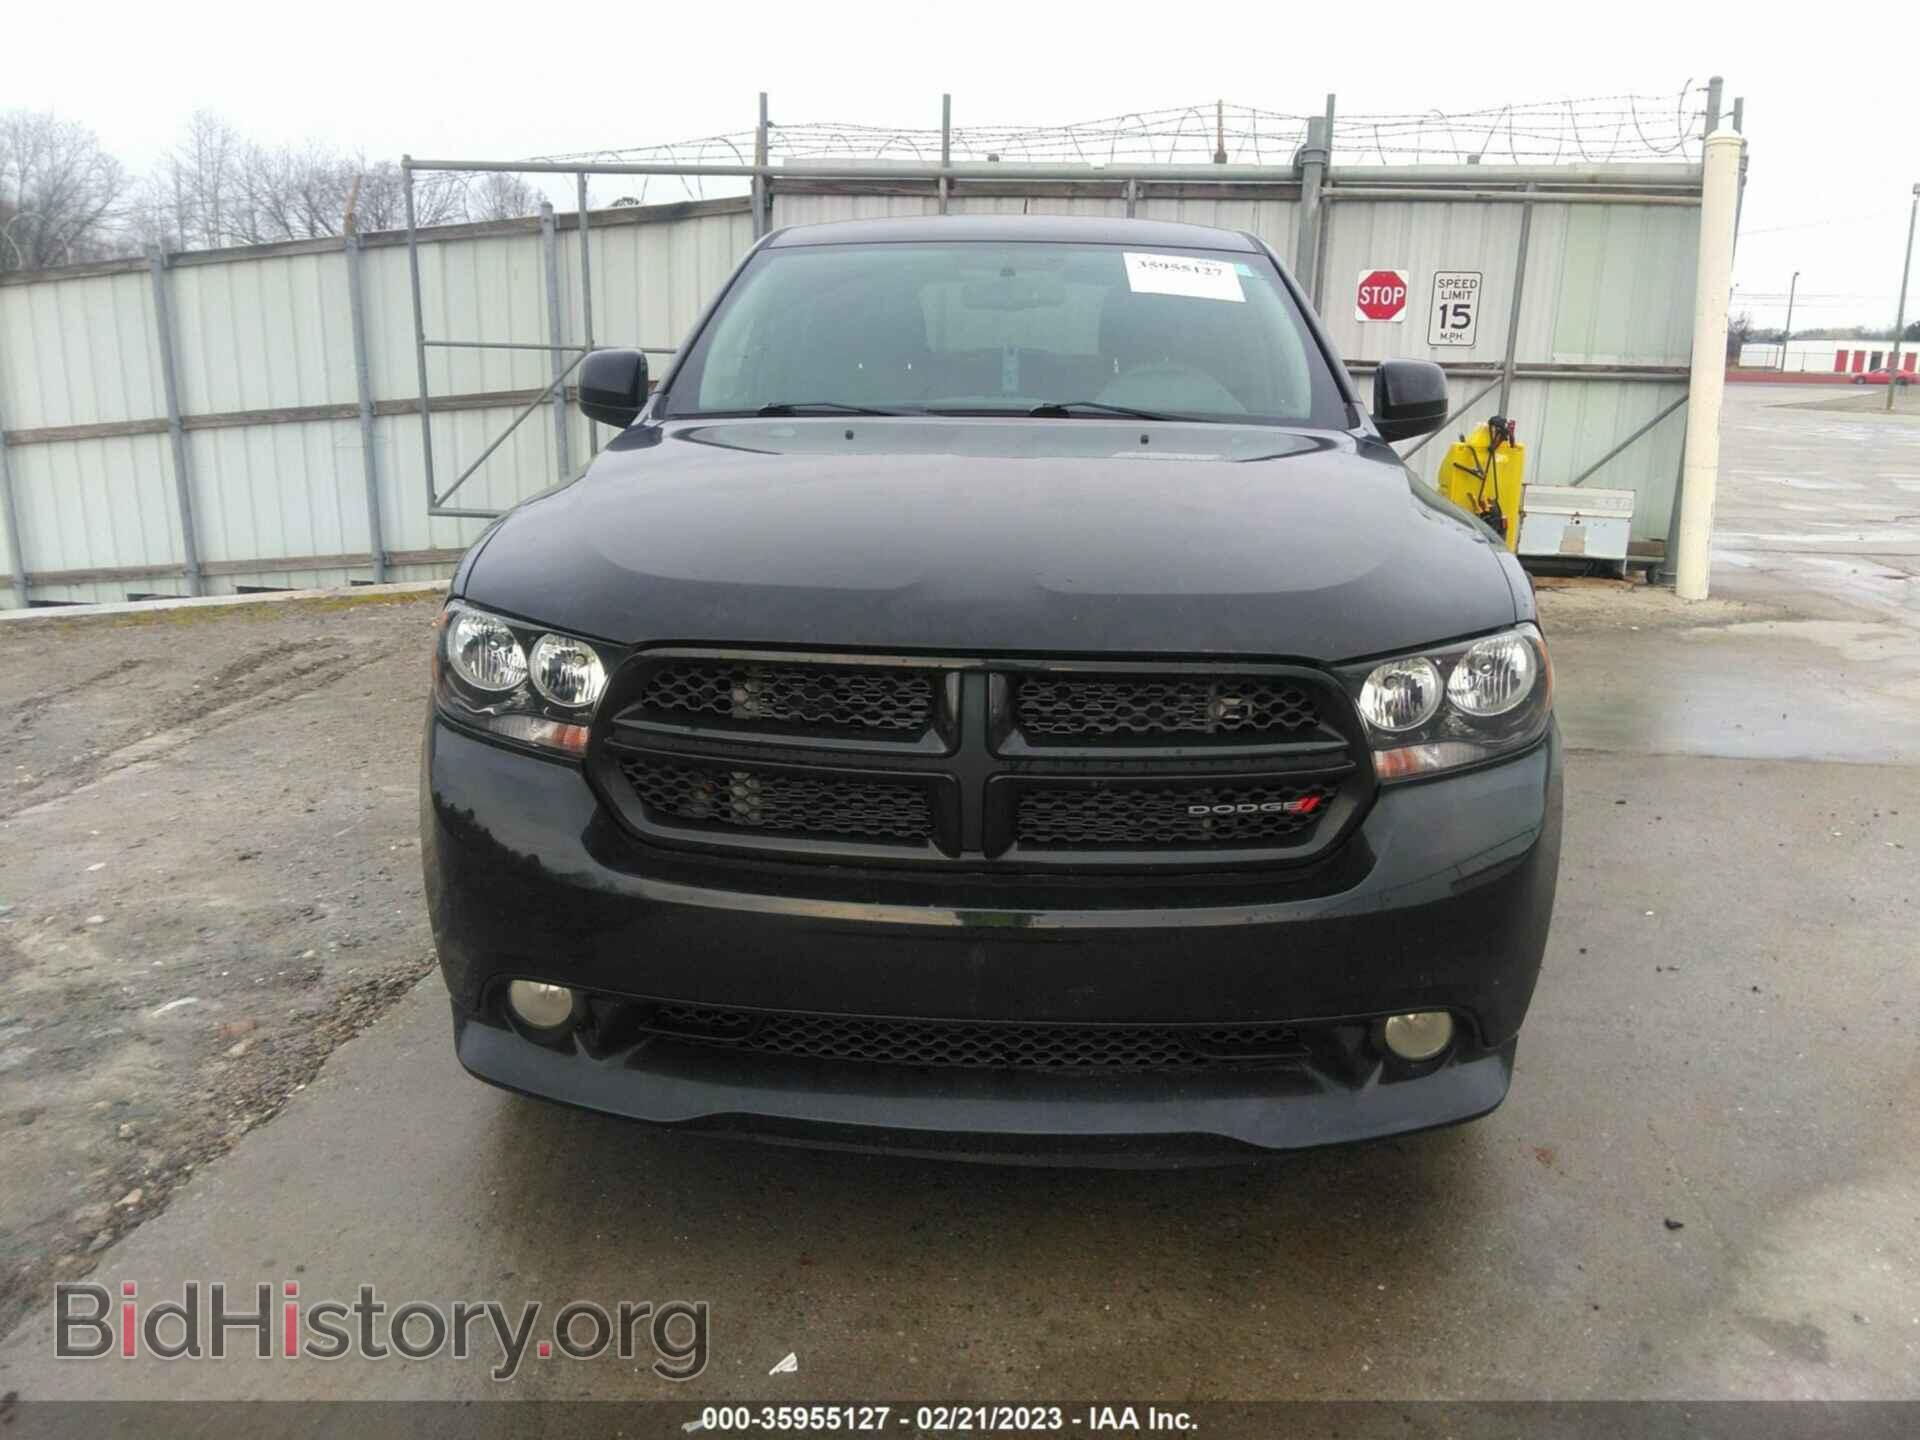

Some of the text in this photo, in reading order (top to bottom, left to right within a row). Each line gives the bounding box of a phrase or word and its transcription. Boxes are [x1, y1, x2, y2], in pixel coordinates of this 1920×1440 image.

[1438, 279, 1478, 289] SPEED
[1359, 286, 1405, 305] STOP
[1440, 290, 1473, 301] LIMIT
[1439, 303, 1471, 329] 15
[1188, 801, 1302, 814] DODGE
